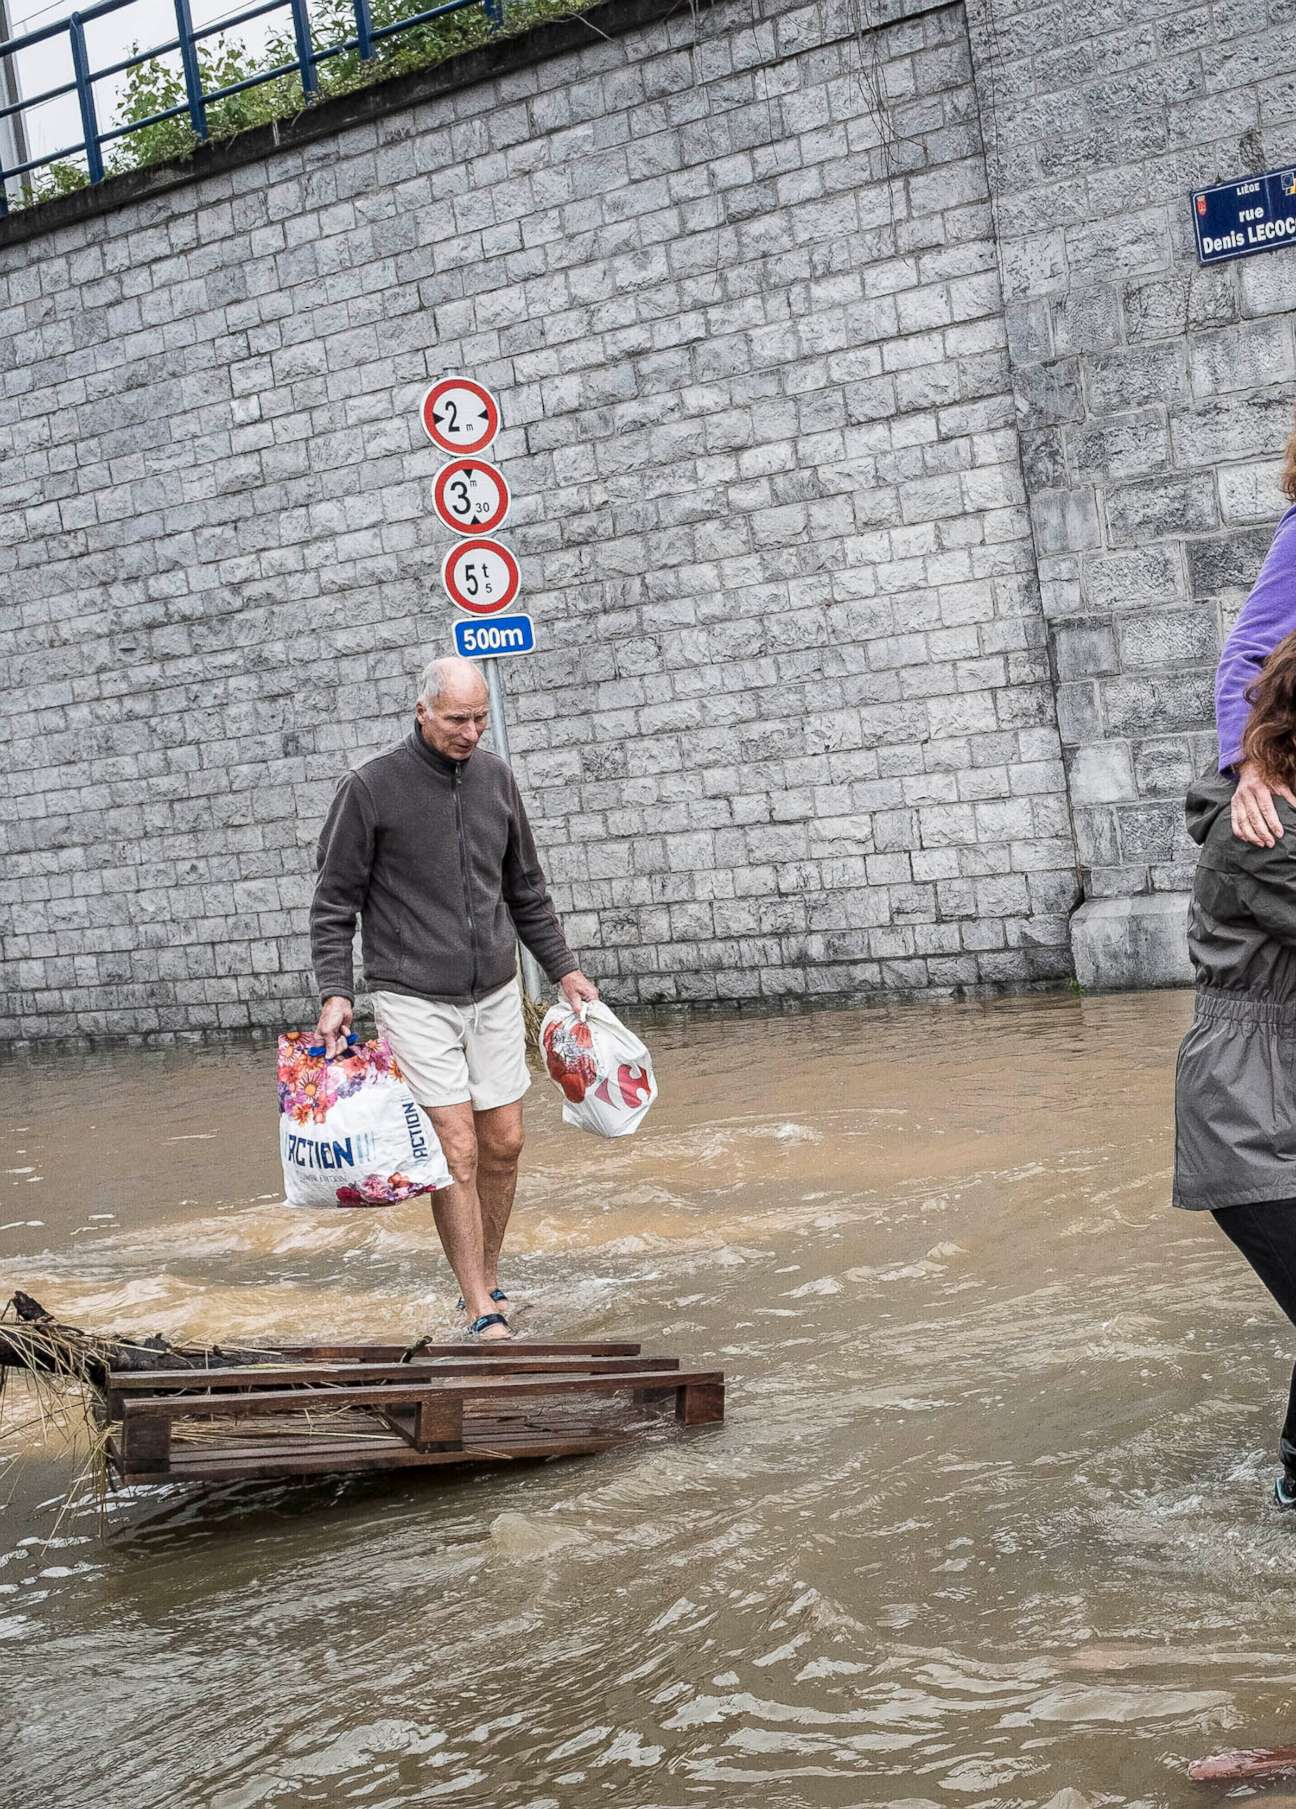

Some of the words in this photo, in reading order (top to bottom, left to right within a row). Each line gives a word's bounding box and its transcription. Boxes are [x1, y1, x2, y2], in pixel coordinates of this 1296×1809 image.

[1239, 207, 1264, 222] rue
[1203, 231, 1245, 254] Denis
[445, 401, 460, 432] 2
[466, 423, 474, 431] m
[450, 481, 471, 514] 3
[476, 503, 490, 513] 30
[465, 564, 478, 595] 5
[482, 563, 489, 578] t
[485, 583, 493, 593] 5
[464, 628, 524, 651] 500m
[403, 1102, 428, 1160] ACTION
[288, 1134, 354, 1168] ACTION
